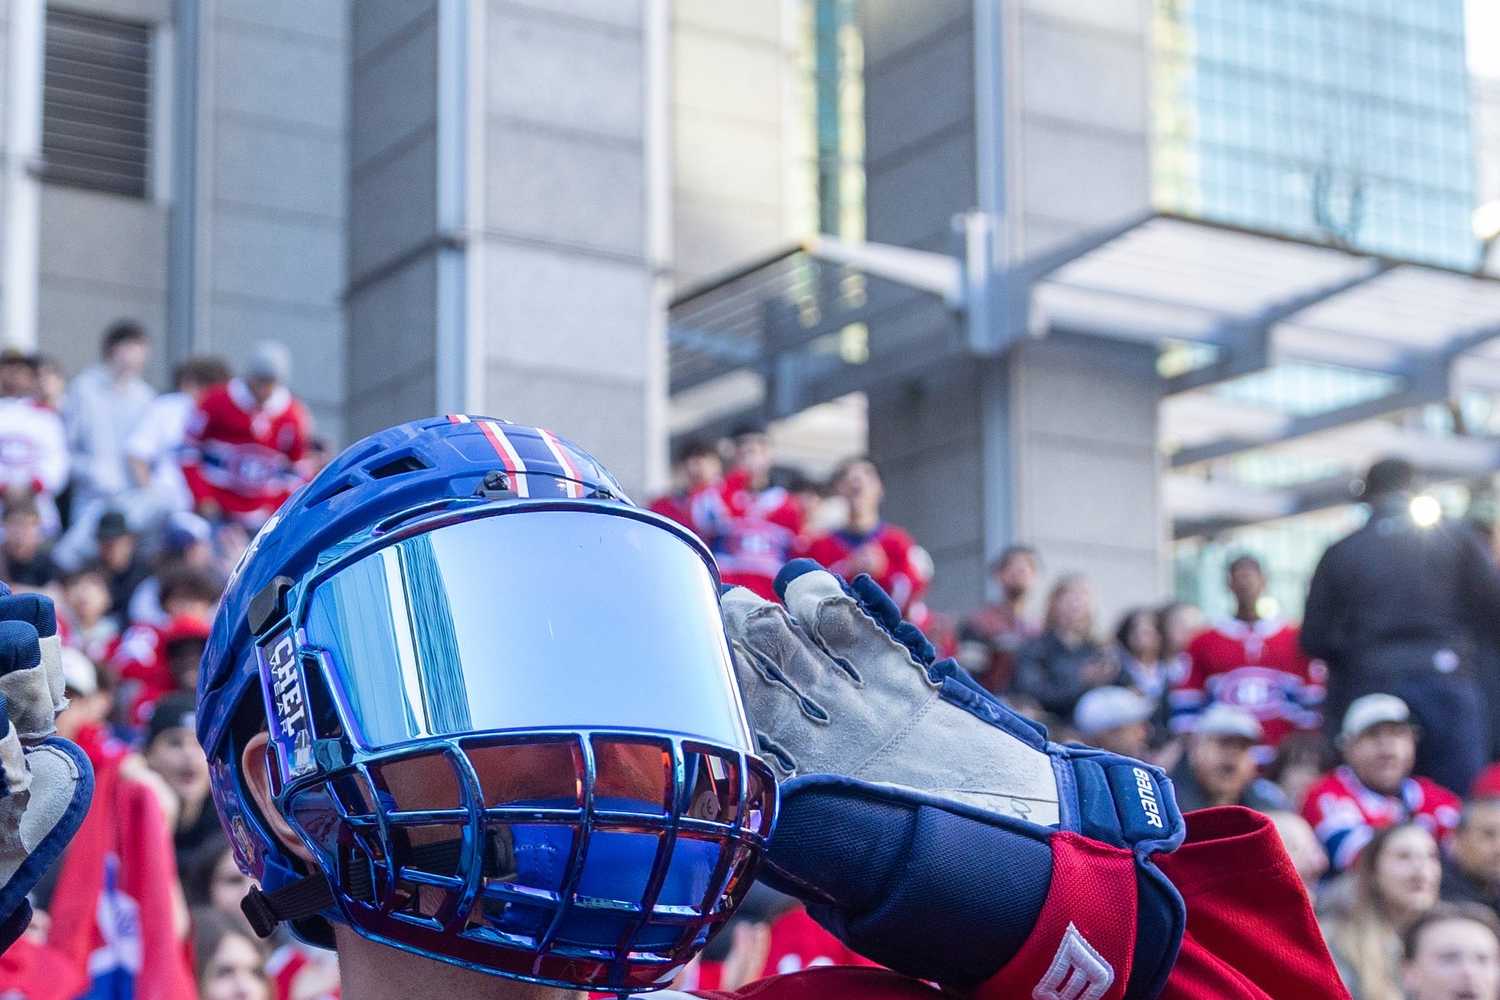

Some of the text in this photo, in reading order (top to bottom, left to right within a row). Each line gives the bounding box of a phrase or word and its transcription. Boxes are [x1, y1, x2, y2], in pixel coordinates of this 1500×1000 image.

[268, 653, 289, 735] WEAR
[274, 635, 305, 738] CHEL
[1132, 767, 1163, 829] BAUER
